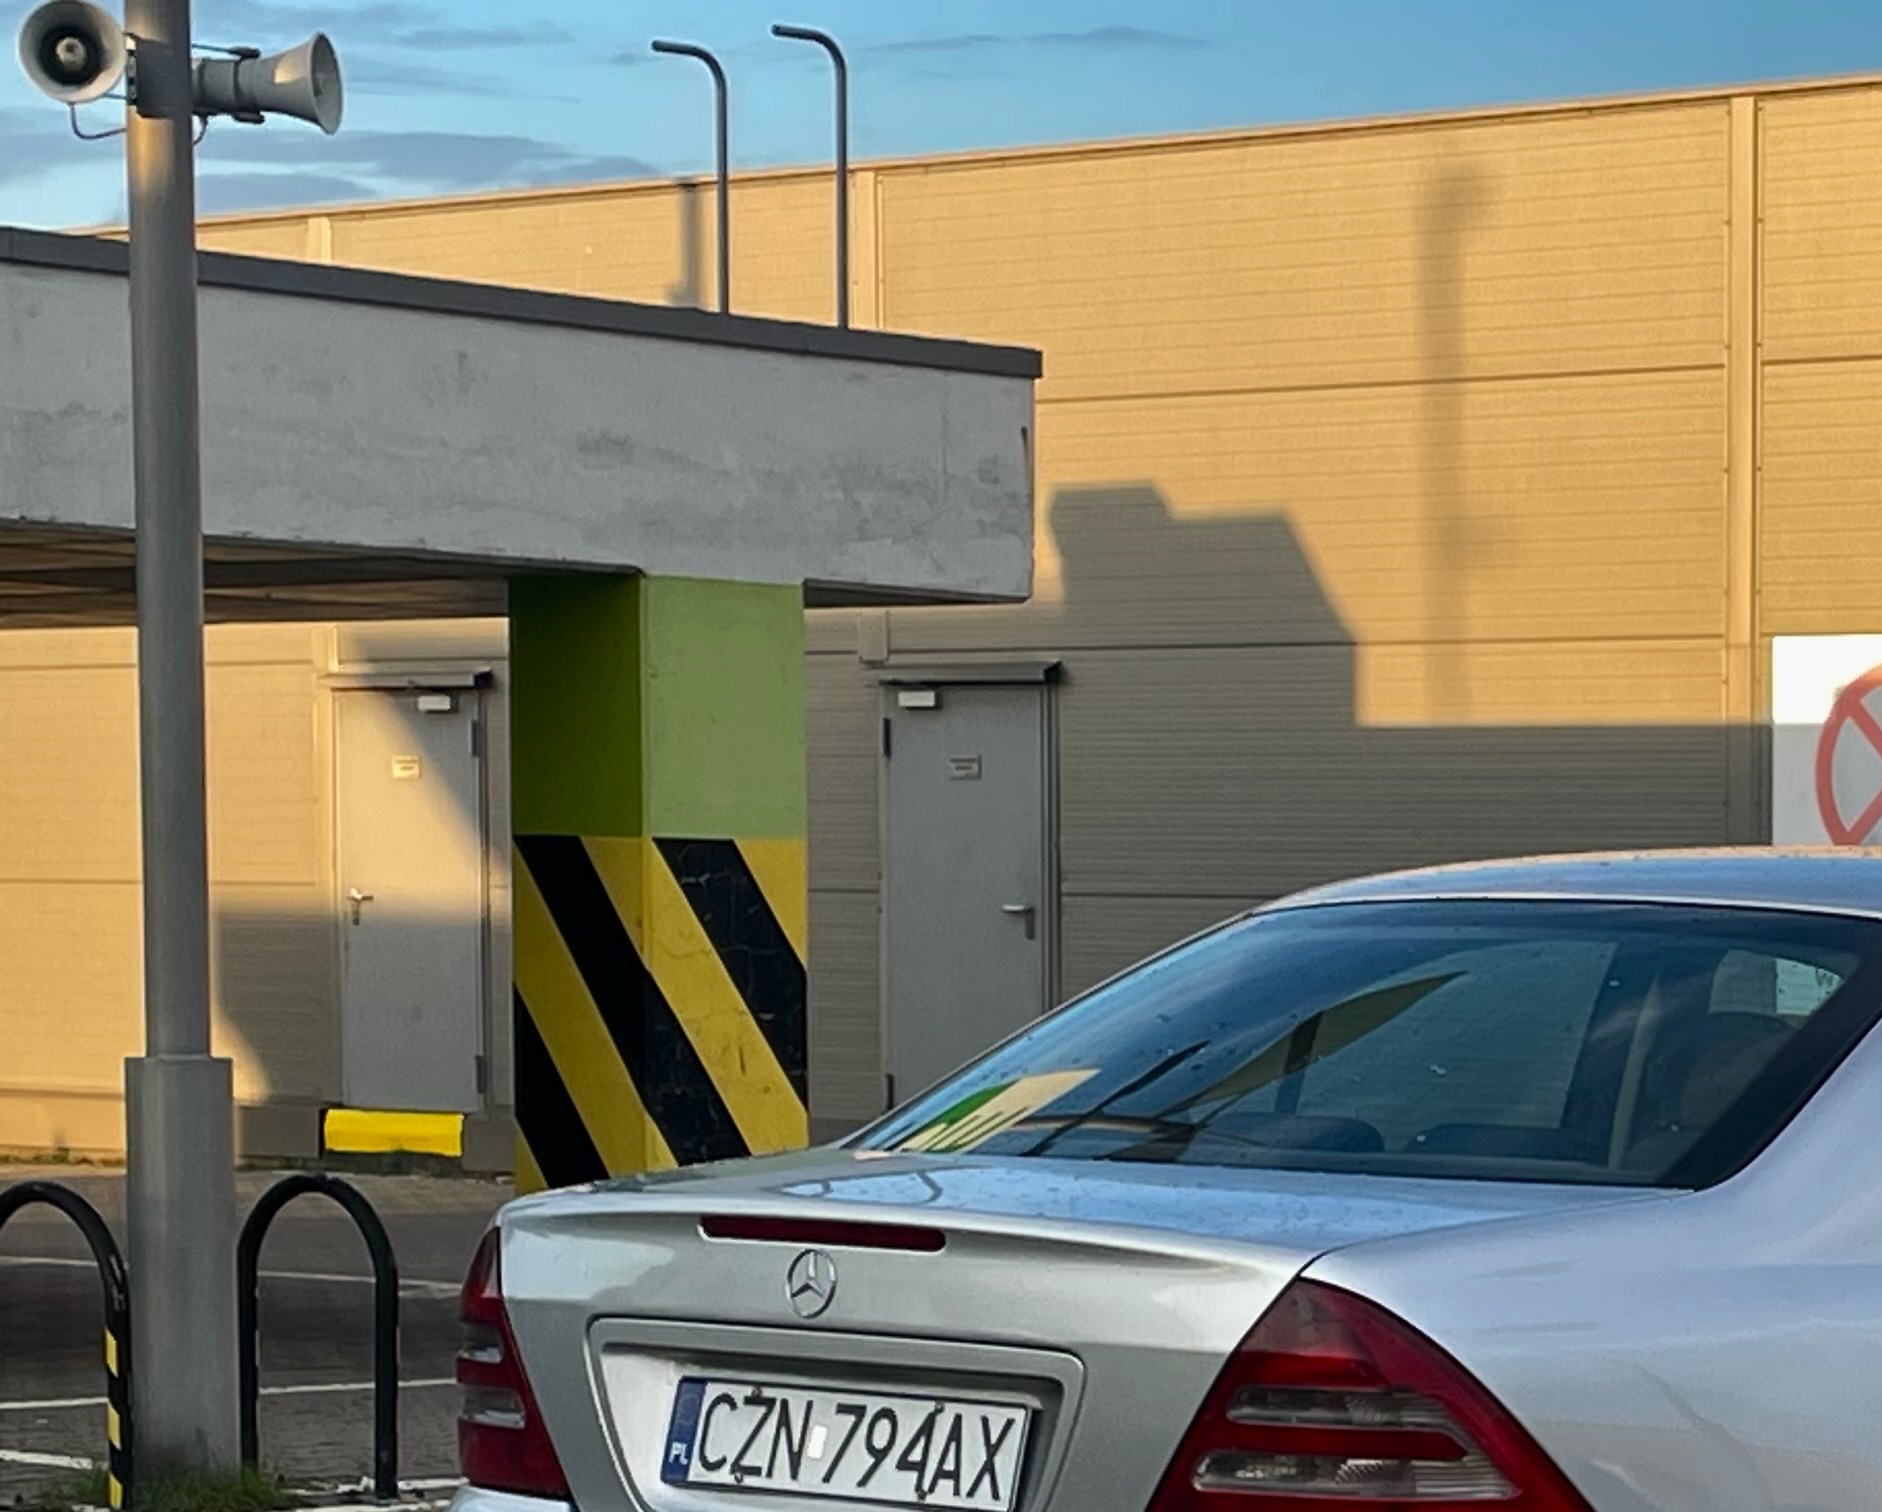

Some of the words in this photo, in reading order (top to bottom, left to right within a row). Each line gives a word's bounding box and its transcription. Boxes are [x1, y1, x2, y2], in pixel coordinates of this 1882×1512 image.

[668, 1441, 689, 1465] PL
[698, 1393, 814, 1481] CZN
[821, 1402, 1015, 1501] 794AX
